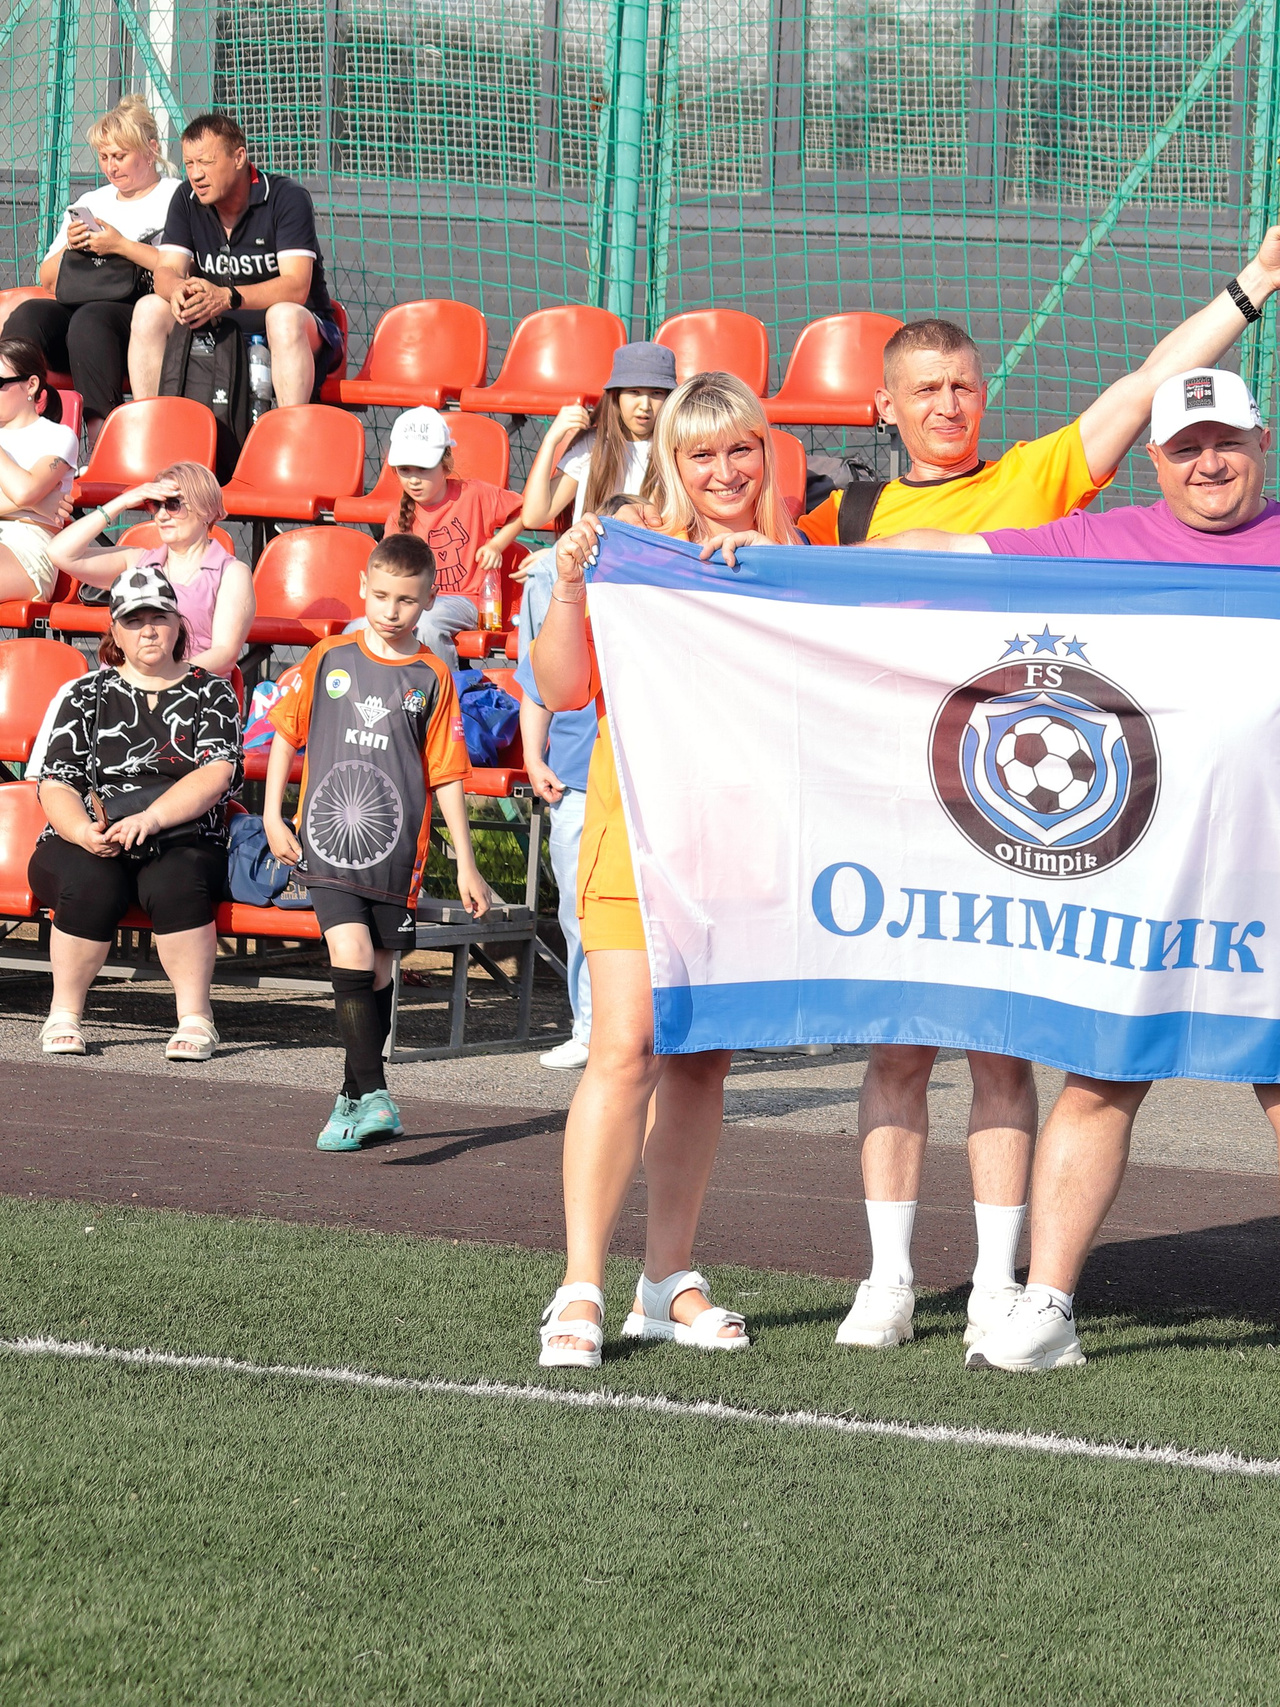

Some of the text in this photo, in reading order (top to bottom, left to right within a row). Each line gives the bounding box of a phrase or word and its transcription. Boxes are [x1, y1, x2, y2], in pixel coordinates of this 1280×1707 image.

[196, 250, 279, 276] LACOSTE
[1023, 664, 1064, 688] FS
[344, 728, 389, 751] КНП
[995, 843, 1098, 876] Olimpik
